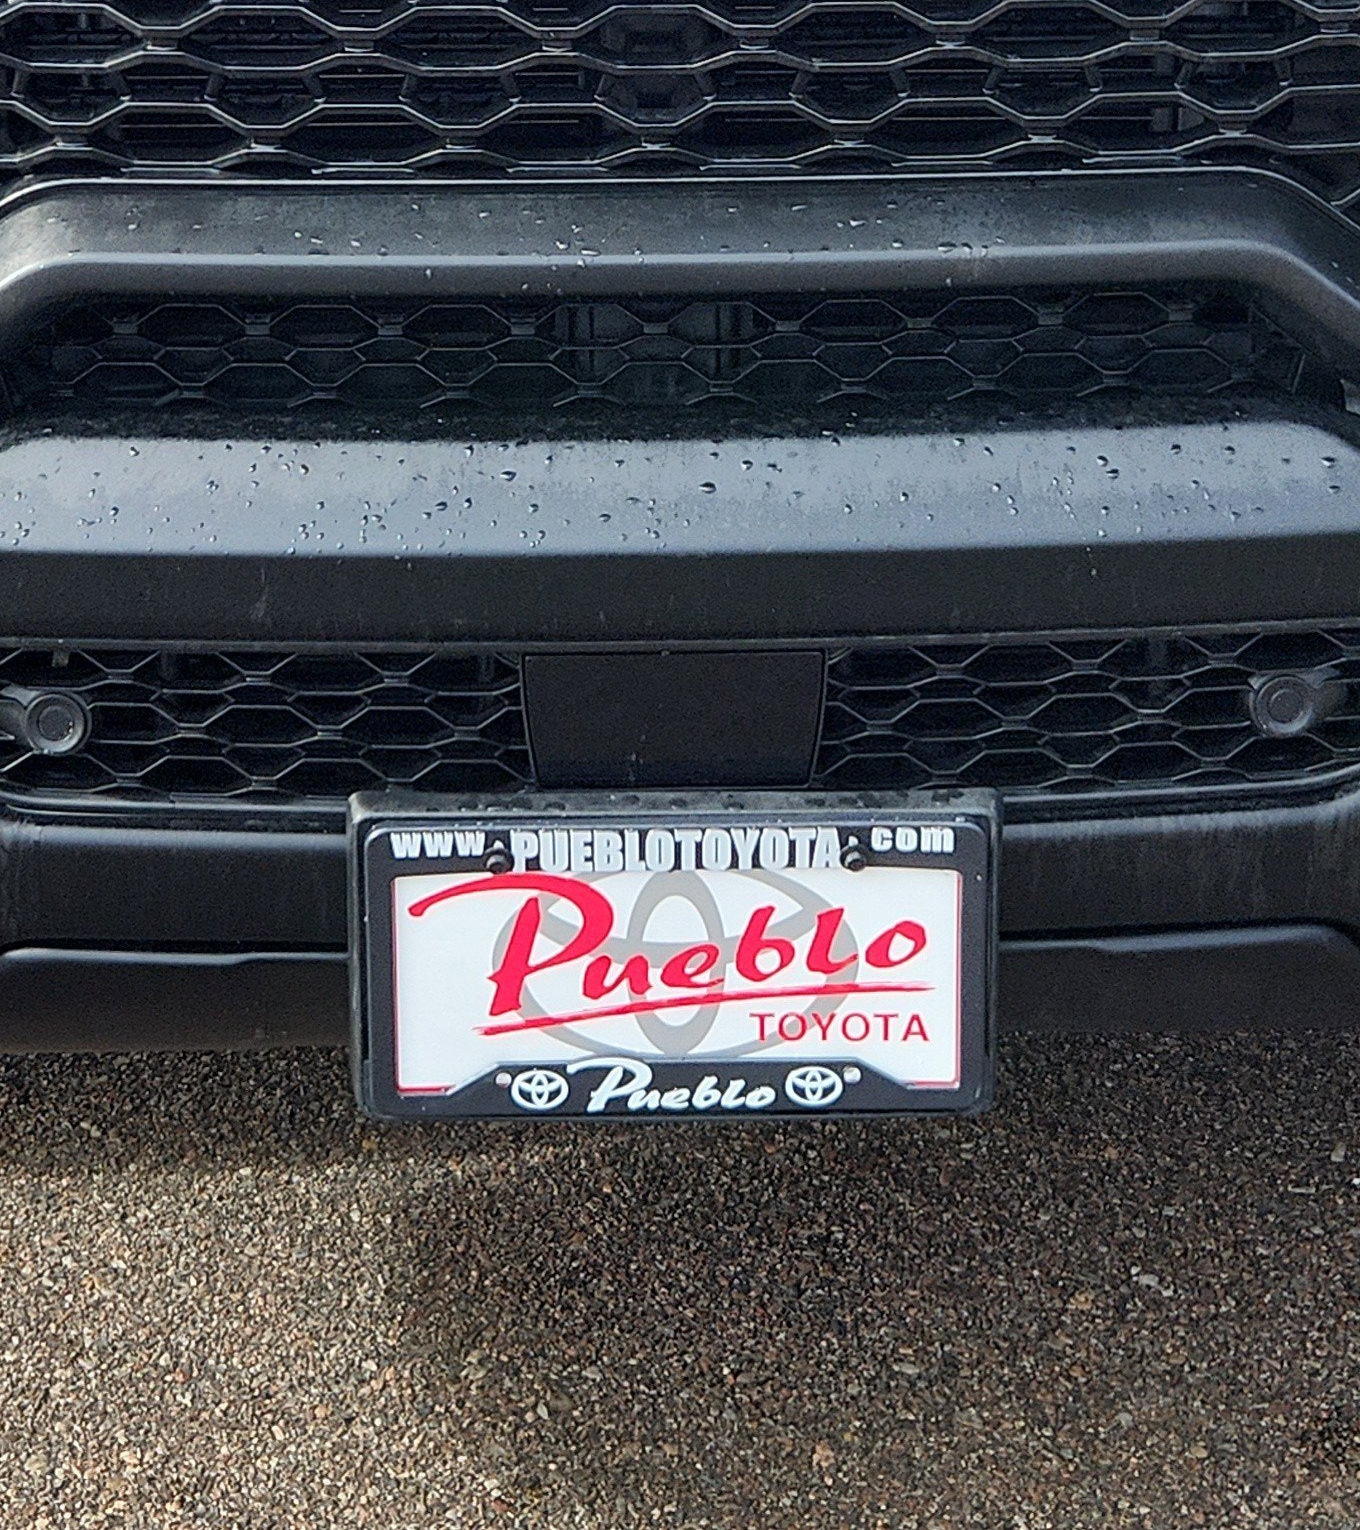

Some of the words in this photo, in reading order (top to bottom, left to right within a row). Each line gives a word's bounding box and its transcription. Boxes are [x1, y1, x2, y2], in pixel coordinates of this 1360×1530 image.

[408, 873, 928, 1016] Pueblo
[750, 1012, 930, 1043] TOYOTA
[566, 1056, 777, 1113] Pueblo
